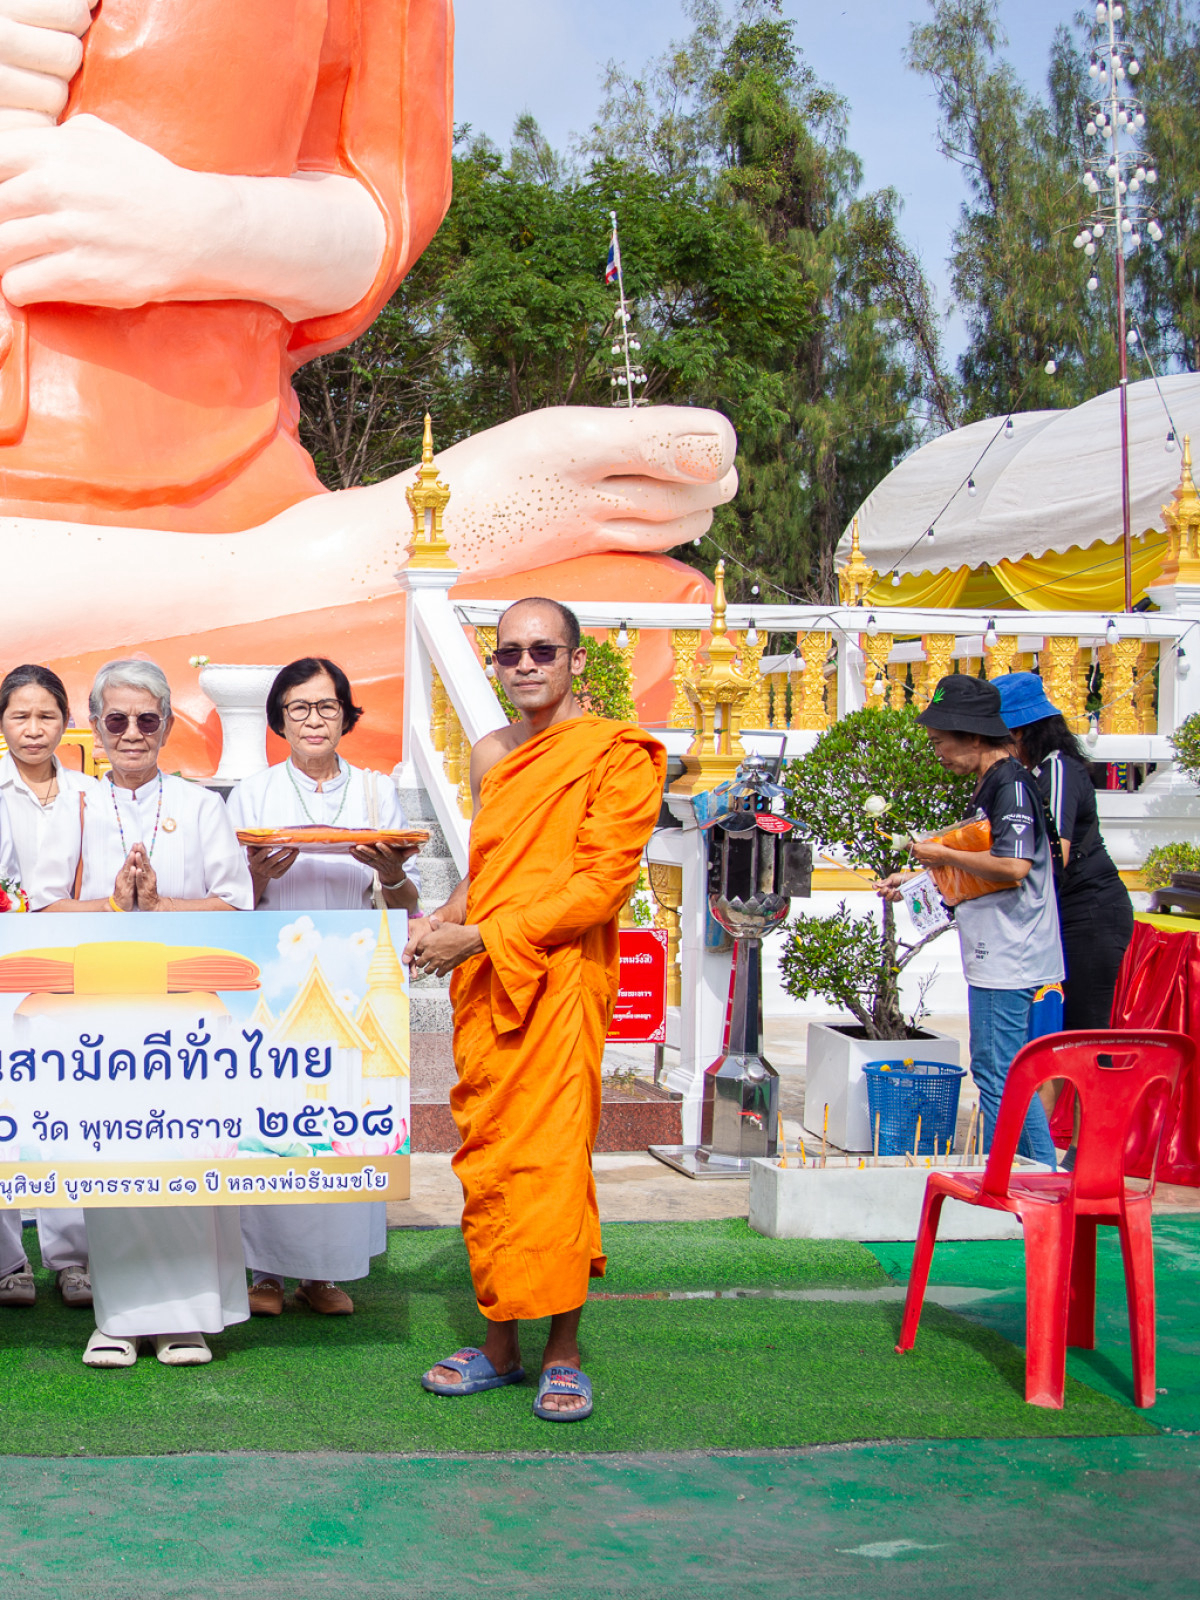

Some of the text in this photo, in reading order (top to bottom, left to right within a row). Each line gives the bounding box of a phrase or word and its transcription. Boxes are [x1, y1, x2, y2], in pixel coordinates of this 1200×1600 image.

[32, 1110, 69, 1142] วัด
[79, 1109, 243, 1152] พุทธศักราช
[256, 1104, 394, 1138] ๒๕๖๘
[65, 1178, 159, 1201] บูชาธรรม
[168, 1179, 197, 1193] ๘๑
[205, 1171, 219, 1192] ปี
[228, 1168, 387, 1191] หลวงพ่อธัมมชโย
